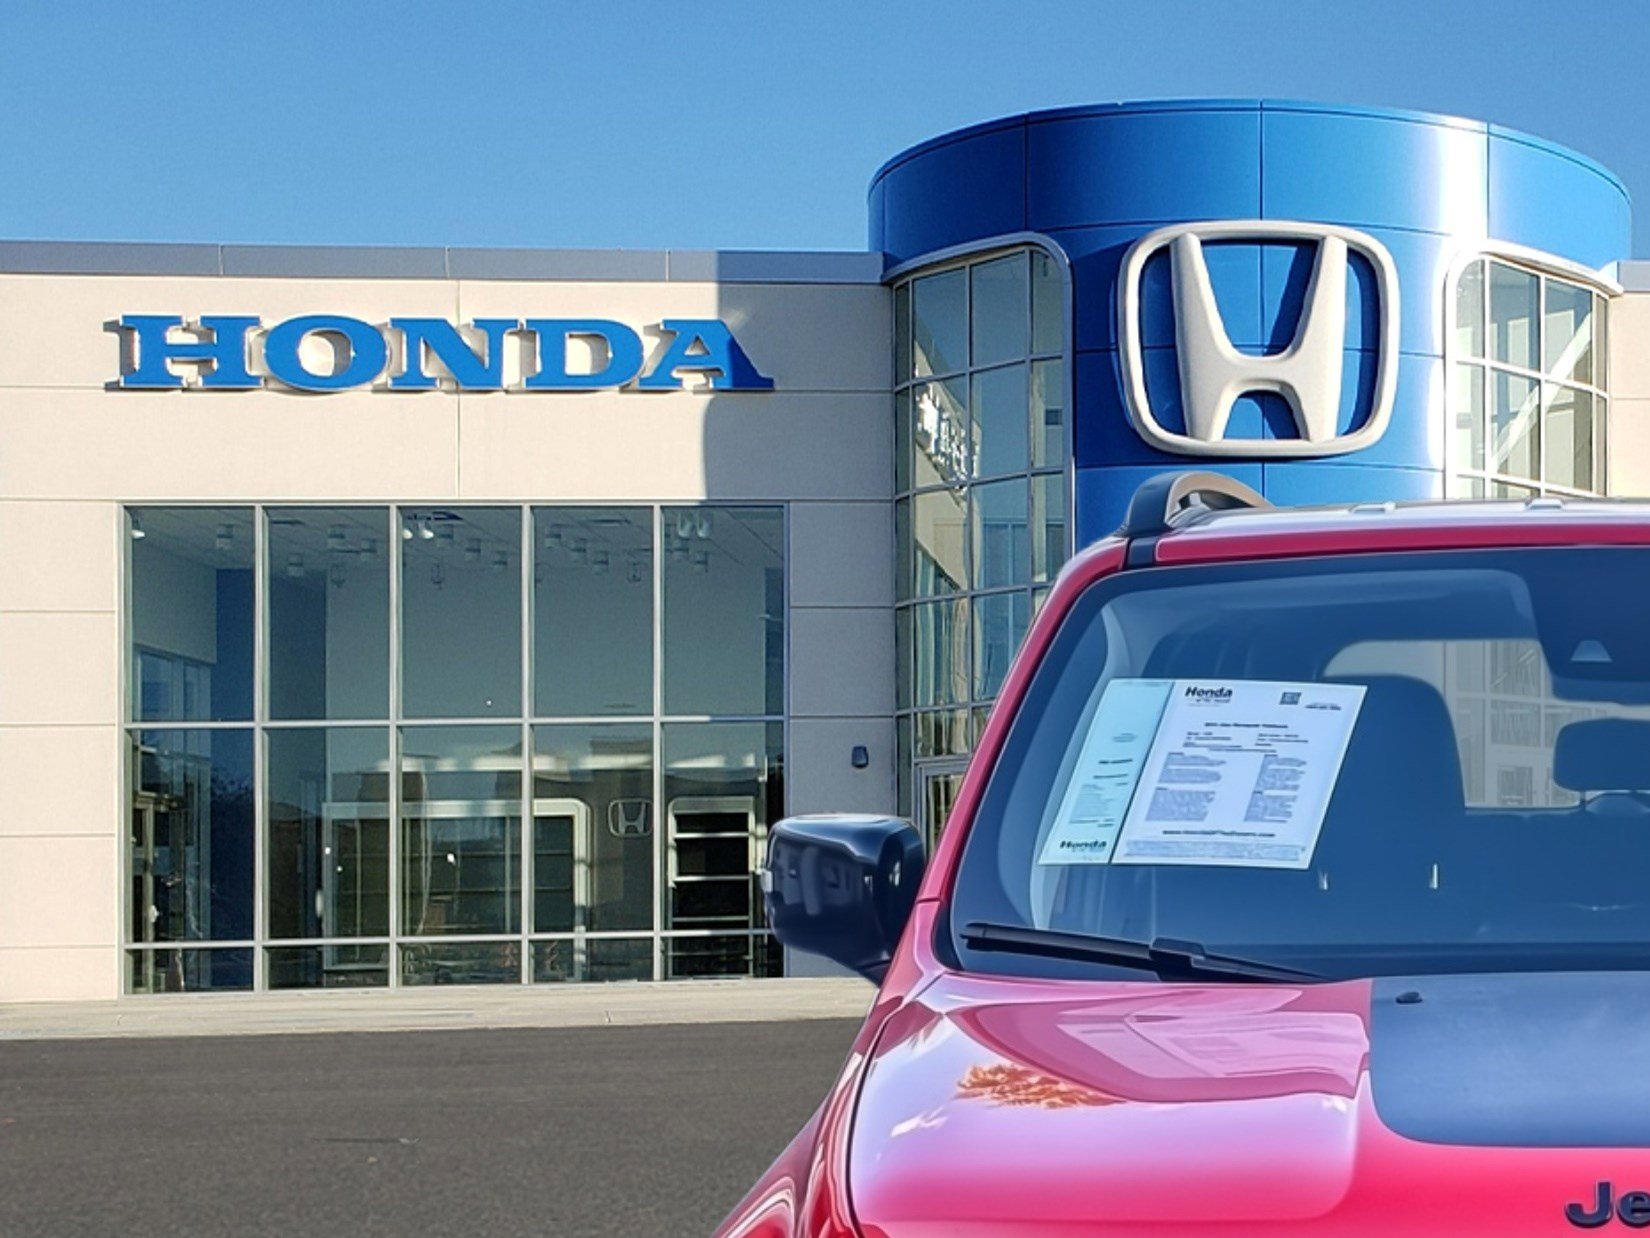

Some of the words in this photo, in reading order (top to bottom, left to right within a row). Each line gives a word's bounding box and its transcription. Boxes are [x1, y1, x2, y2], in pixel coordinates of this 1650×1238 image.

[118, 313, 775, 391] HONDA
[1184, 685, 1233, 698] Honda
[1058, 838, 1108, 850] Honda
